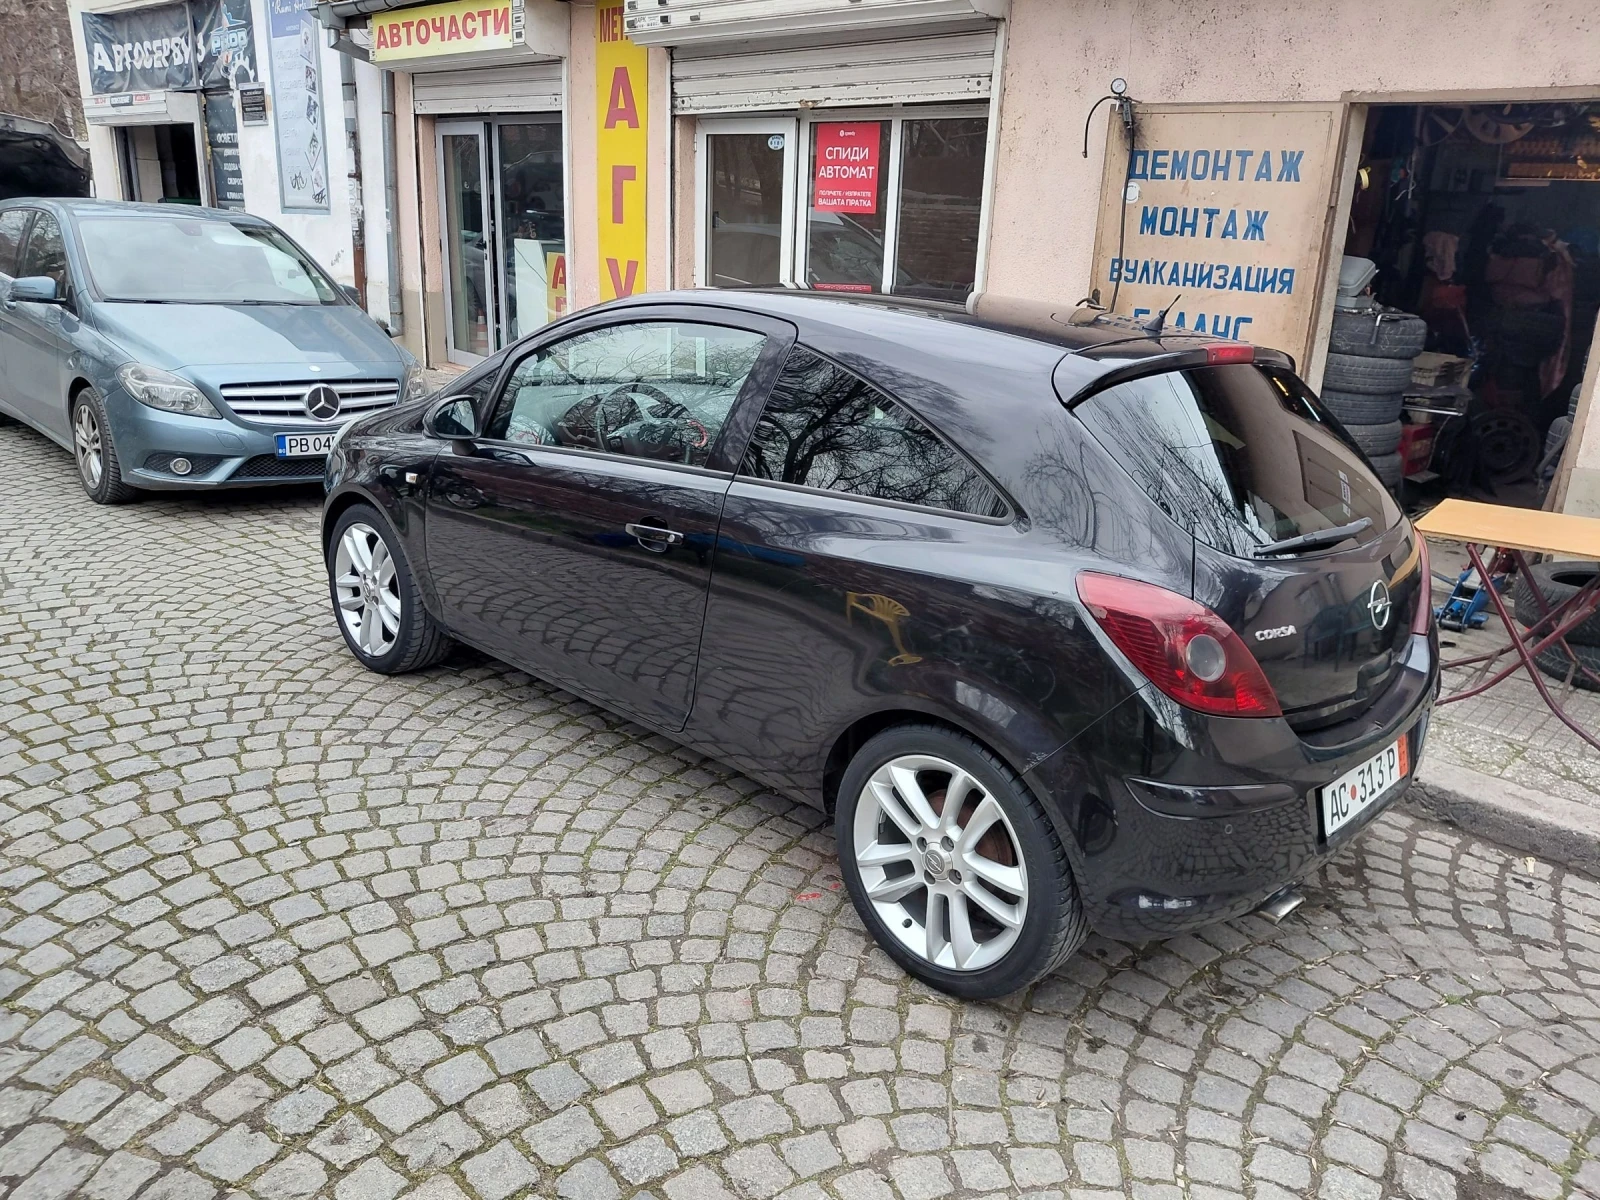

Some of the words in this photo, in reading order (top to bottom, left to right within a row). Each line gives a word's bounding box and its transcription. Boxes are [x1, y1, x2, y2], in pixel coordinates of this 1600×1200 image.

[376, 7, 510, 50] АВТОЧАСТИ
[600, 6, 629, 43] МЕТ
[826, 147, 869, 162] СПИДИ
[1128, 149, 1305, 183] ДЕМОНТАЖ
[818, 165, 875, 179] АВТОМАТ
[818, 197, 845, 206] ВАШАТА
[845, 198, 872, 207] ПРАТКА
[1139, 205, 1269, 241] МОНТАЖ
[1108, 257, 1296, 295] ВУЛКАНИЗАЦИЯ
[1134, 308, 1253, 340] ЛАНС
[288, 437, 310, 454] PB
[313, 435, 336, 452] 04
[1255, 624, 1297, 641] CORSA
[1330, 782, 1349, 827] AC
[1357, 754, 1385, 804] 313
